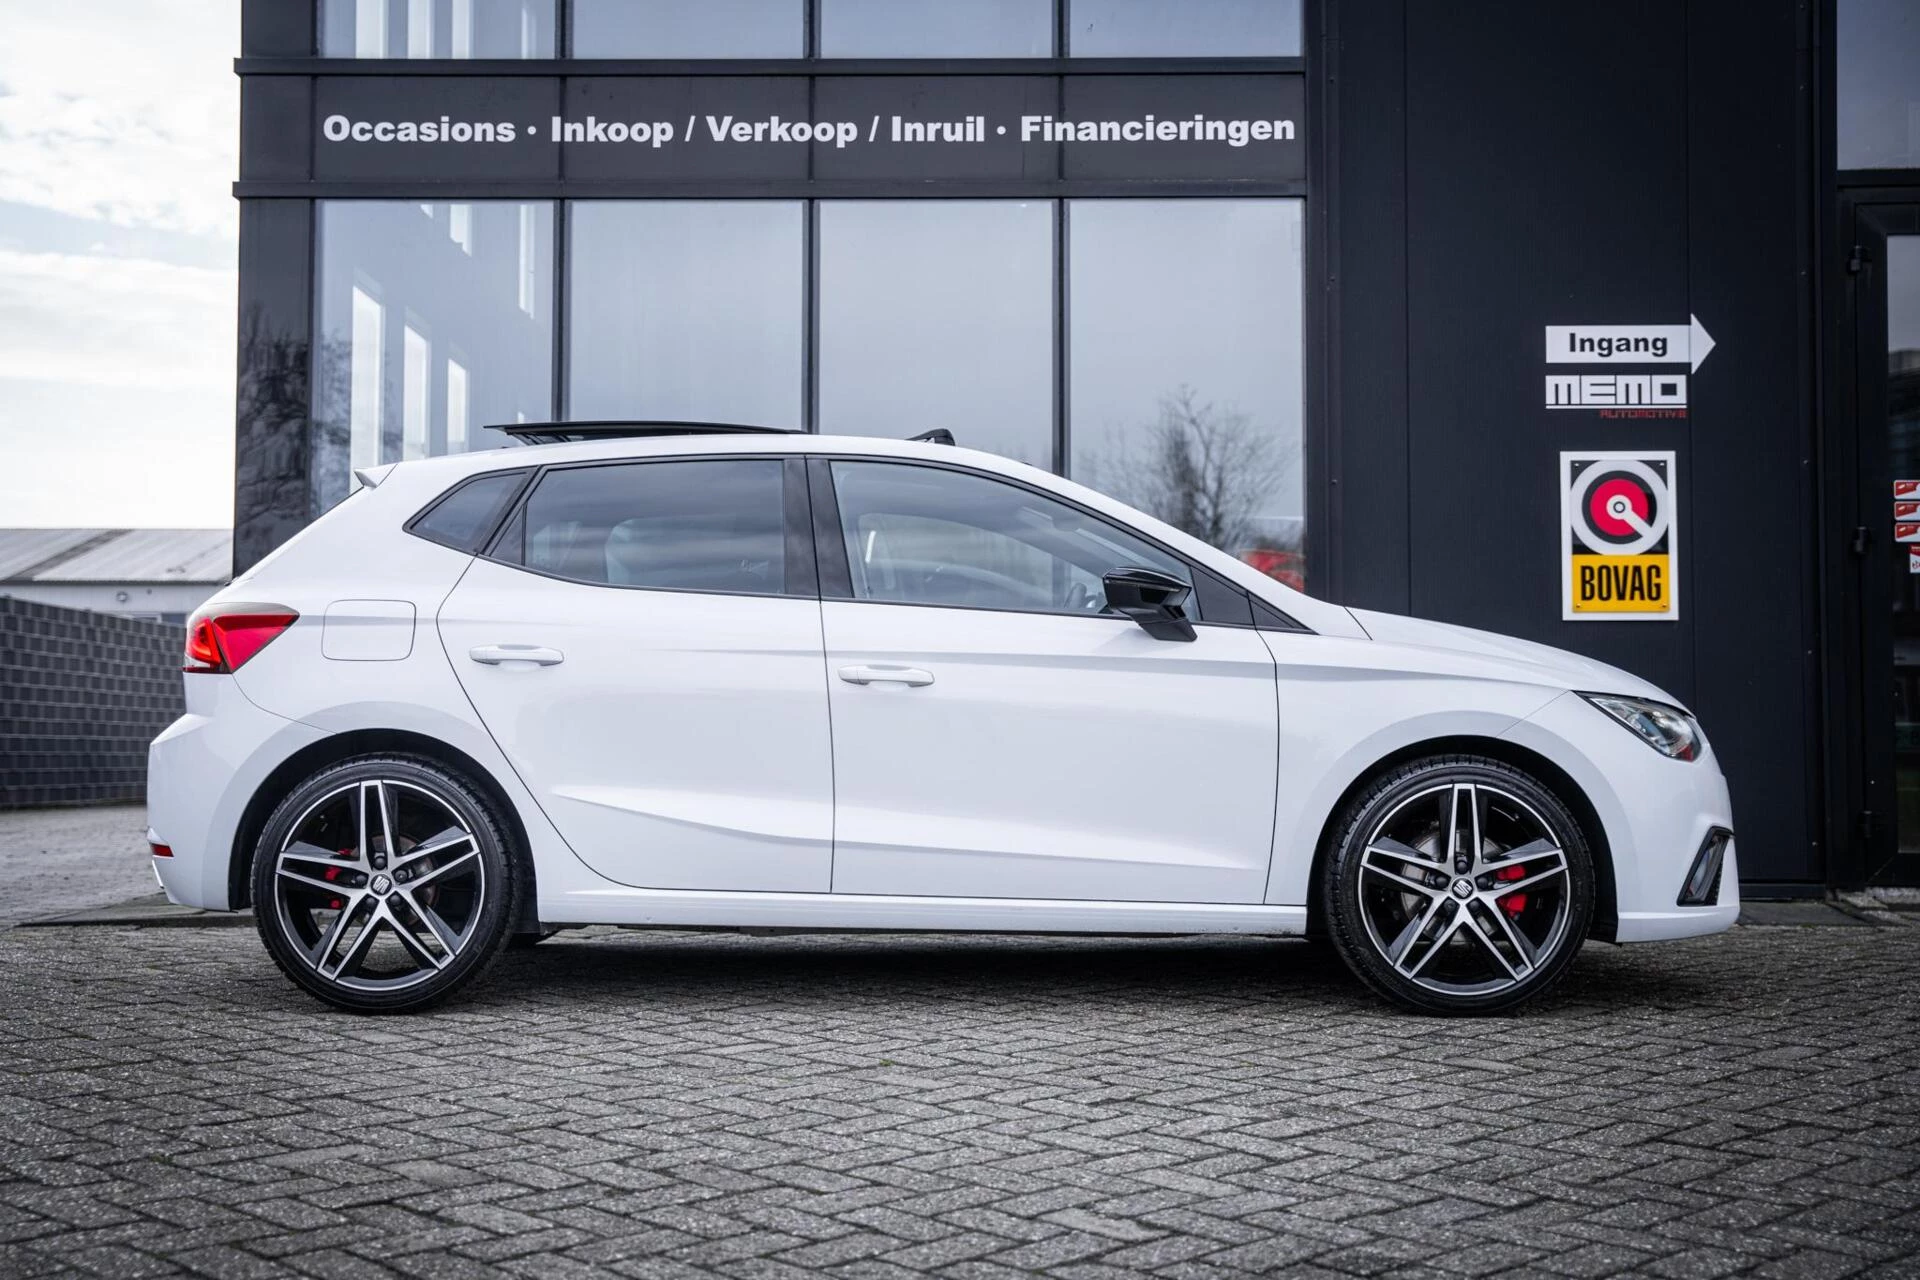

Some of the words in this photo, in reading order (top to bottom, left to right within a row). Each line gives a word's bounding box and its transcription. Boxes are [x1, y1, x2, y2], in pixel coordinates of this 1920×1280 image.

[323, 114, 516, 143] Occasions
[551, 115, 674, 148] Inkoop
[705, 115, 858, 148] Verkoop
[891, 115, 985, 142] Inruil
[1021, 114, 1295, 147] Financieringen
[1569, 332, 1668, 358] Ingang
[1545, 375, 1687, 405] MEMO
[1580, 564, 1662, 602] BOVAG
